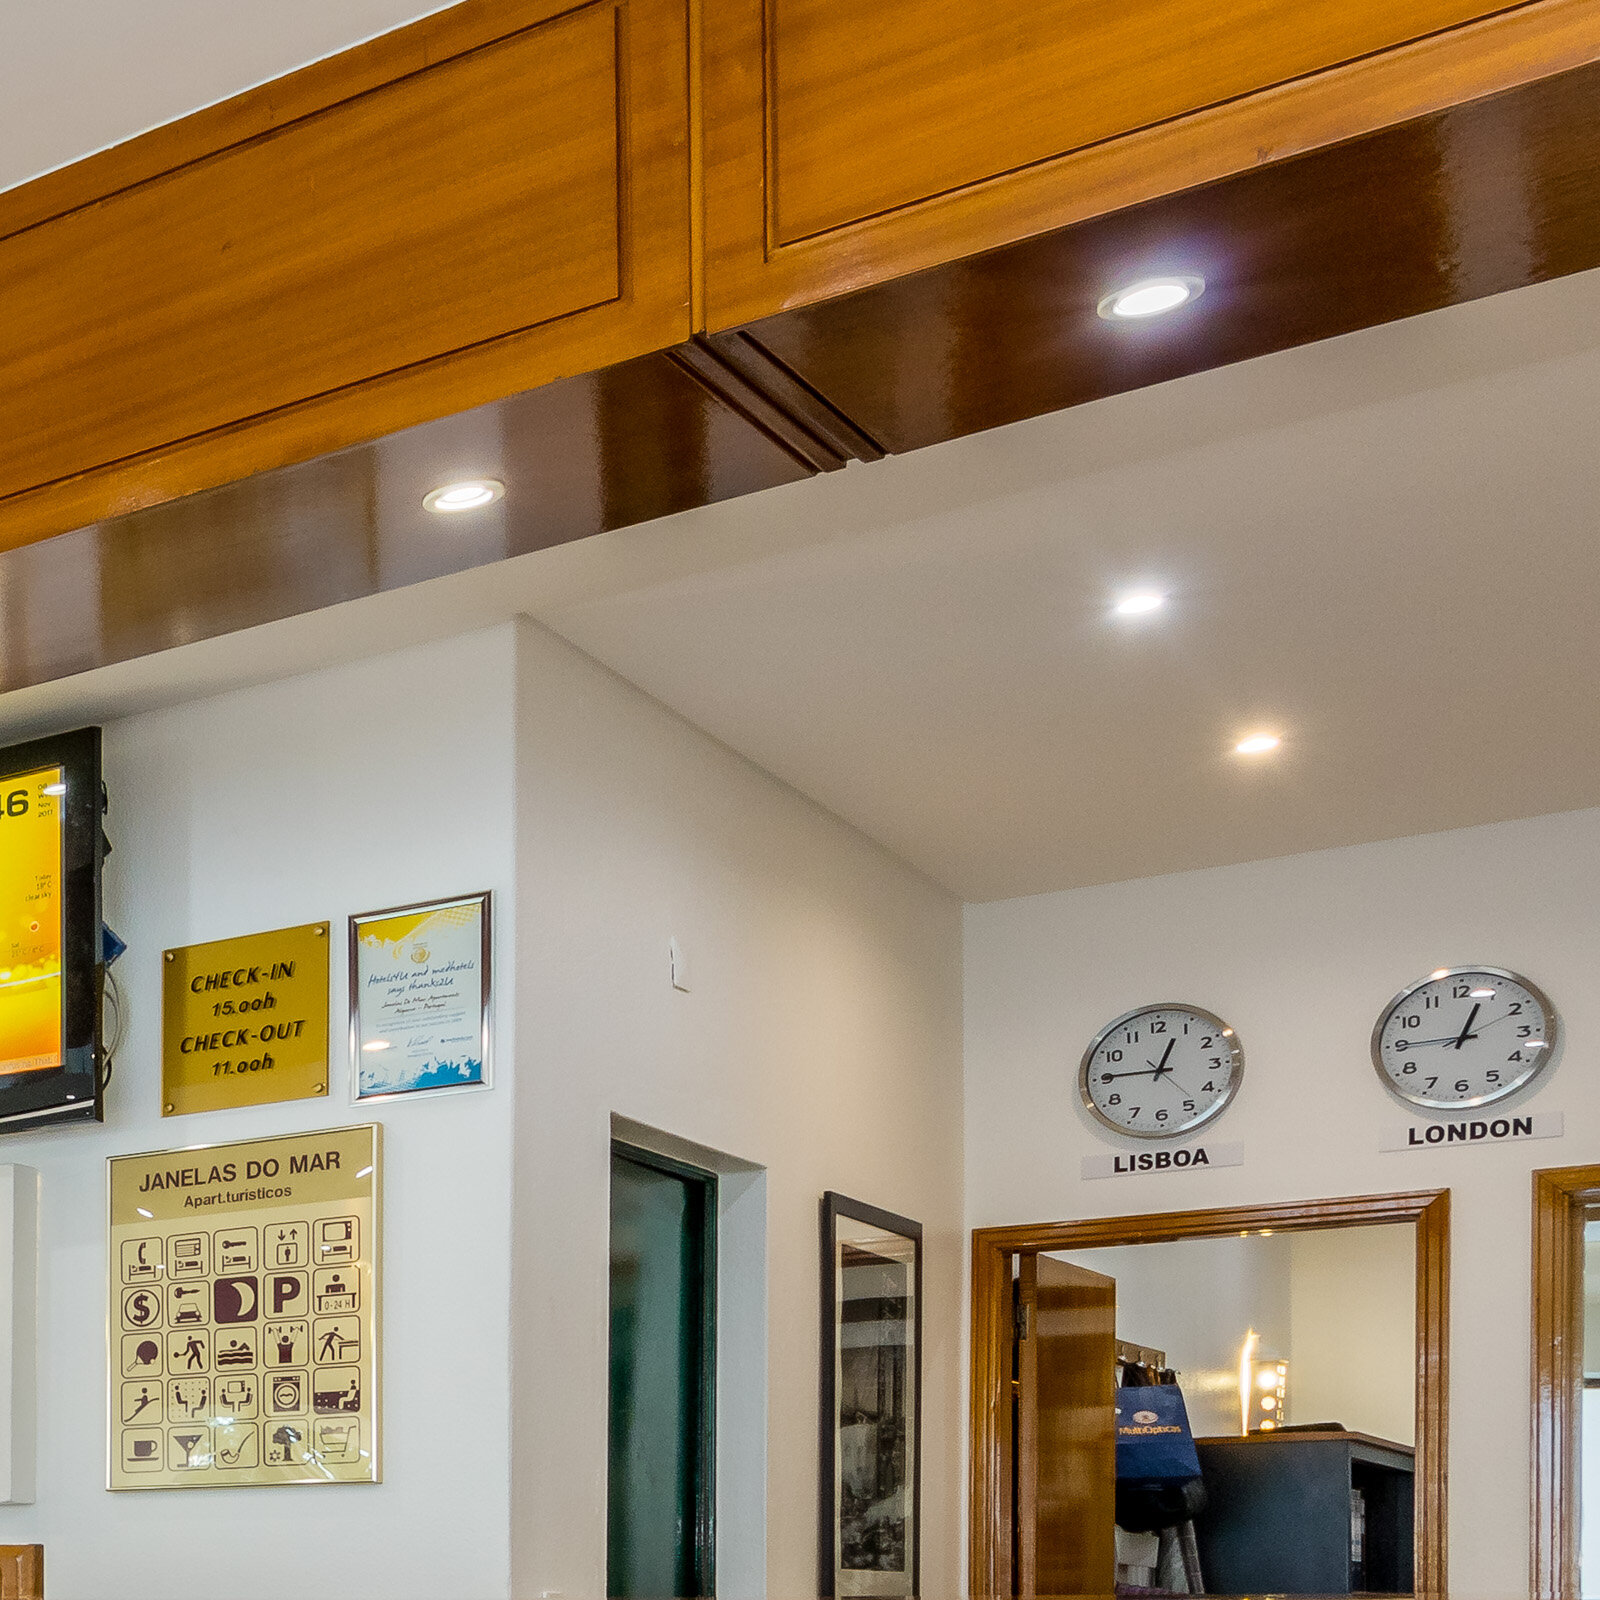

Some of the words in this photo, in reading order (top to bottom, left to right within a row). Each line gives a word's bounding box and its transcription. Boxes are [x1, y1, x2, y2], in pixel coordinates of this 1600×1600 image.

[411, 965, 429, 978] and
[432, 960, 474, 974] medhotels
[190, 961, 294, 993] CHECK-IN
[387, 986, 405, 997] says
[1453, 986, 1470, 999] 12
[1426, 996, 1439, 1009] 11
[1508, 1003, 1522, 1016] 2
[1151, 1021, 1167, 1034] 12
[1402, 1015, 1420, 1028] 10
[1184, 1023, 1188, 1034] 1
[1516, 1025, 1530, 1037] 3
[180, 1020, 305, 1054] CHECK-OUT
[1127, 1032, 1138, 1043] 11
[1201, 1037, 1212, 1049] 2
[1395, 1040, 1408, 1052] 9
[1106, 1050, 1123, 1062] 10
[1508, 1051, 1522, 1062] 4
[1208, 1058, 1221, 1069] 3
[1402, 1062, 1417, 1074] 8
[1101, 1073, 1114, 1084] 9
[1486, 1070, 1499, 1082] 5
[1201, 1081, 1215, 1092] 4
[1425, 1077, 1438, 1089] 7
[1455, 1080, 1469, 1092] 6
[1108, 1094, 1121, 1105] 8
[1183, 1100, 1195, 1111] 5
[1128, 1107, 1141, 1118] 7
[1155, 1110, 1168, 1121] 6
[1409, 1117, 1532, 1145] LONDON
[1114, 1148, 1209, 1173] LISBOA
[139, 1164, 237, 1192] JANELAS
[246, 1158, 280, 1179] DO
[290, 1151, 340, 1174] MAR
[273, 1276, 300, 1313] P
